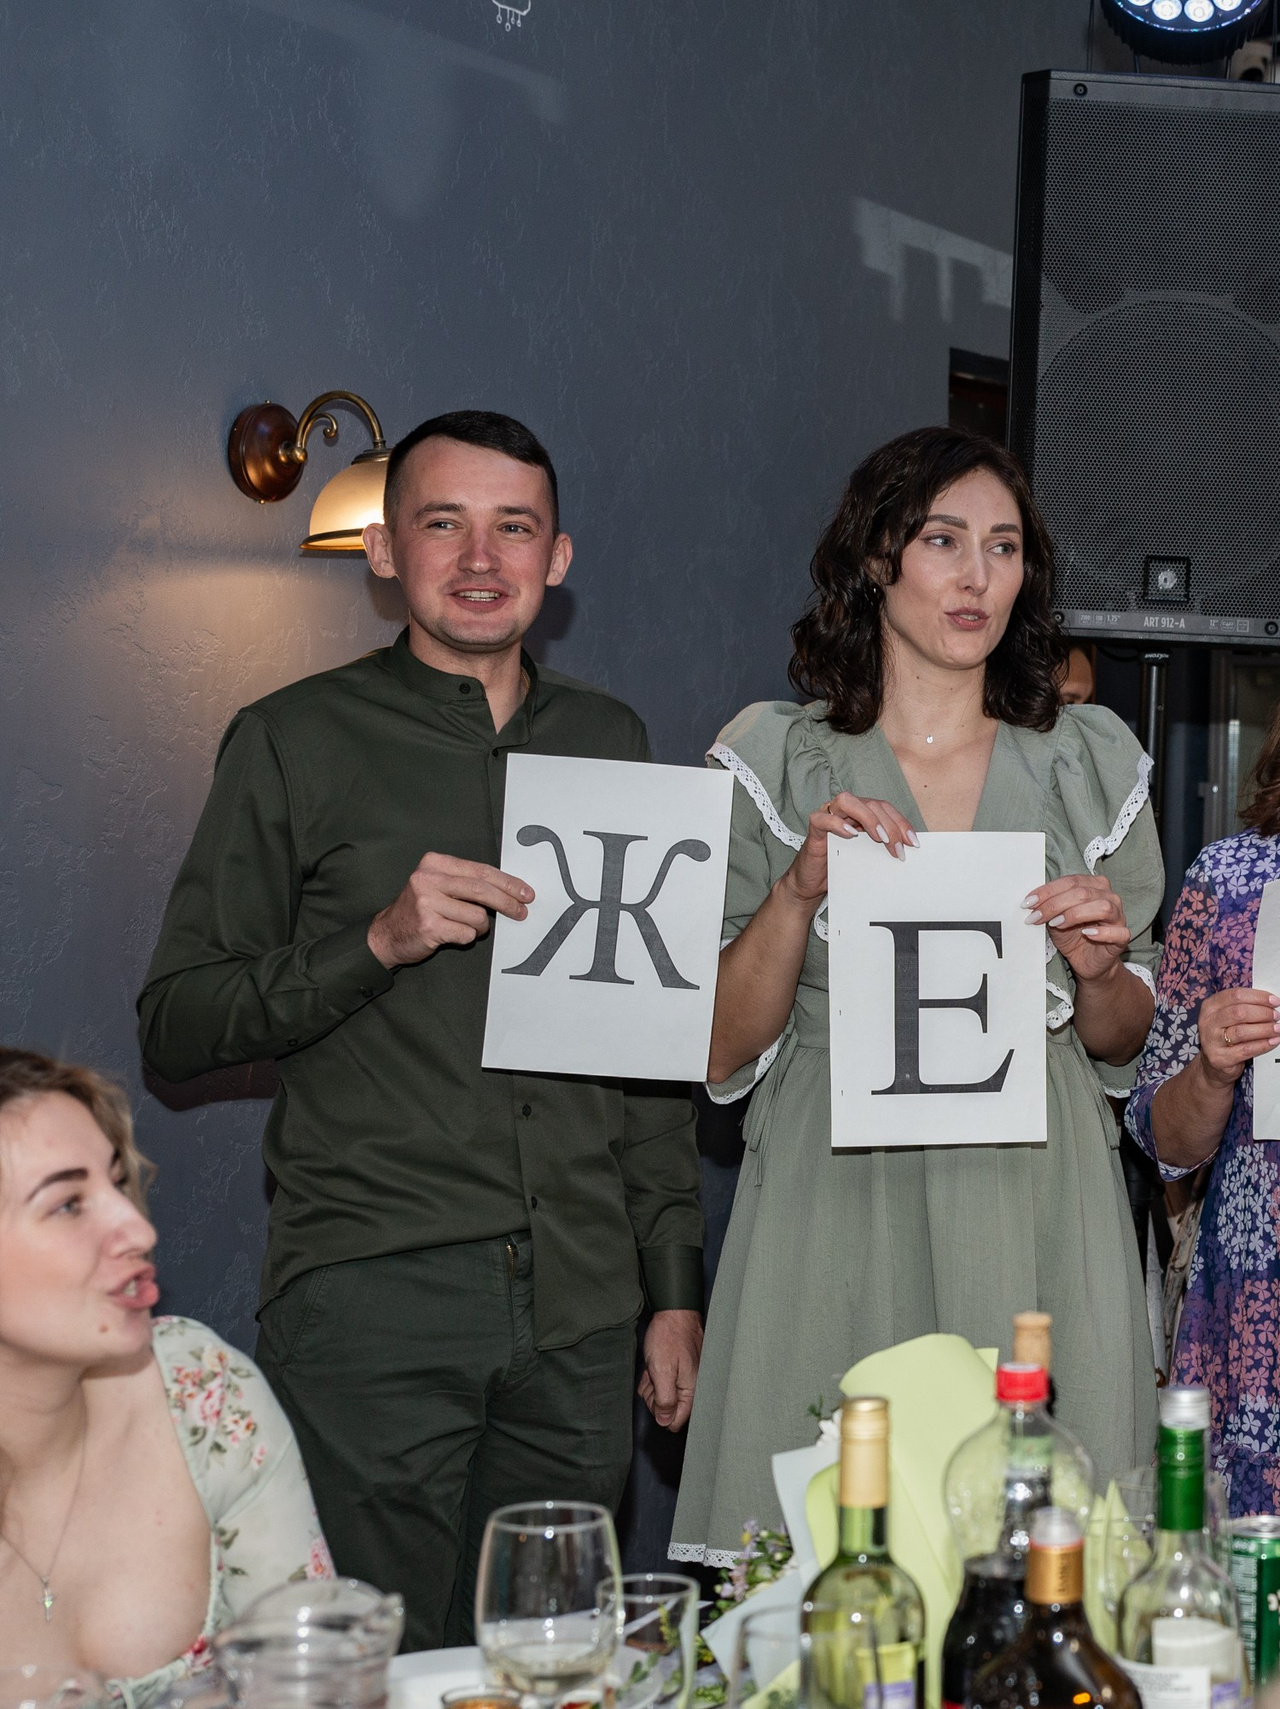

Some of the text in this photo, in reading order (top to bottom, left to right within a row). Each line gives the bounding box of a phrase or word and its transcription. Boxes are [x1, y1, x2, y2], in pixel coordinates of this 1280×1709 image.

[1143, 616, 1186, 629] ART 912-A
[500, 823, 712, 991] Ж
[869, 920, 1016, 1096] Е
